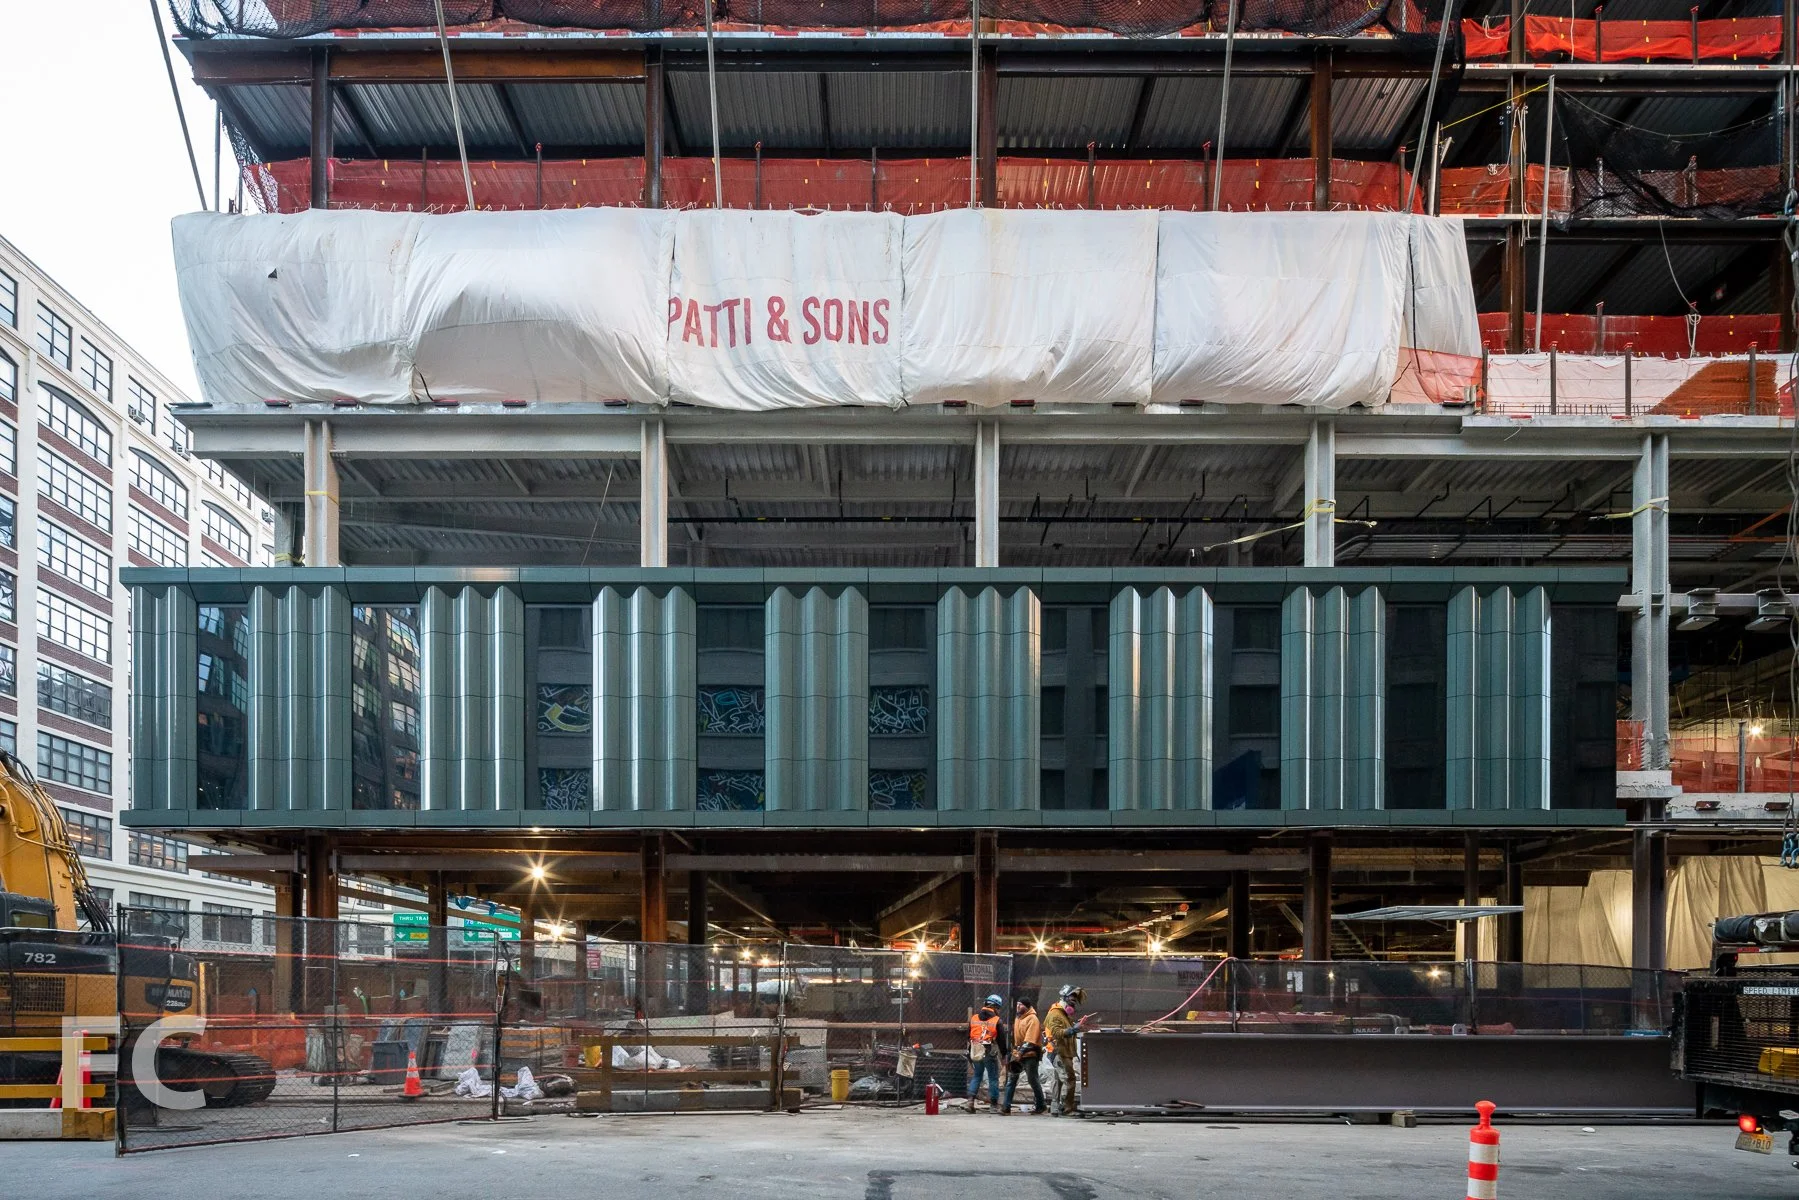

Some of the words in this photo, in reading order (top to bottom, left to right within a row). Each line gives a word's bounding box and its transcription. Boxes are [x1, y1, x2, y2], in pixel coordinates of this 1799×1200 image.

[667, 296, 752, 348] PATTI
[766, 295, 792, 345] &
[802, 295, 890, 346] SONS
[24, 952, 57, 964] 782
[964, 964, 992, 975] NATIONAL
[1743, 986, 1768, 995] SPEED
